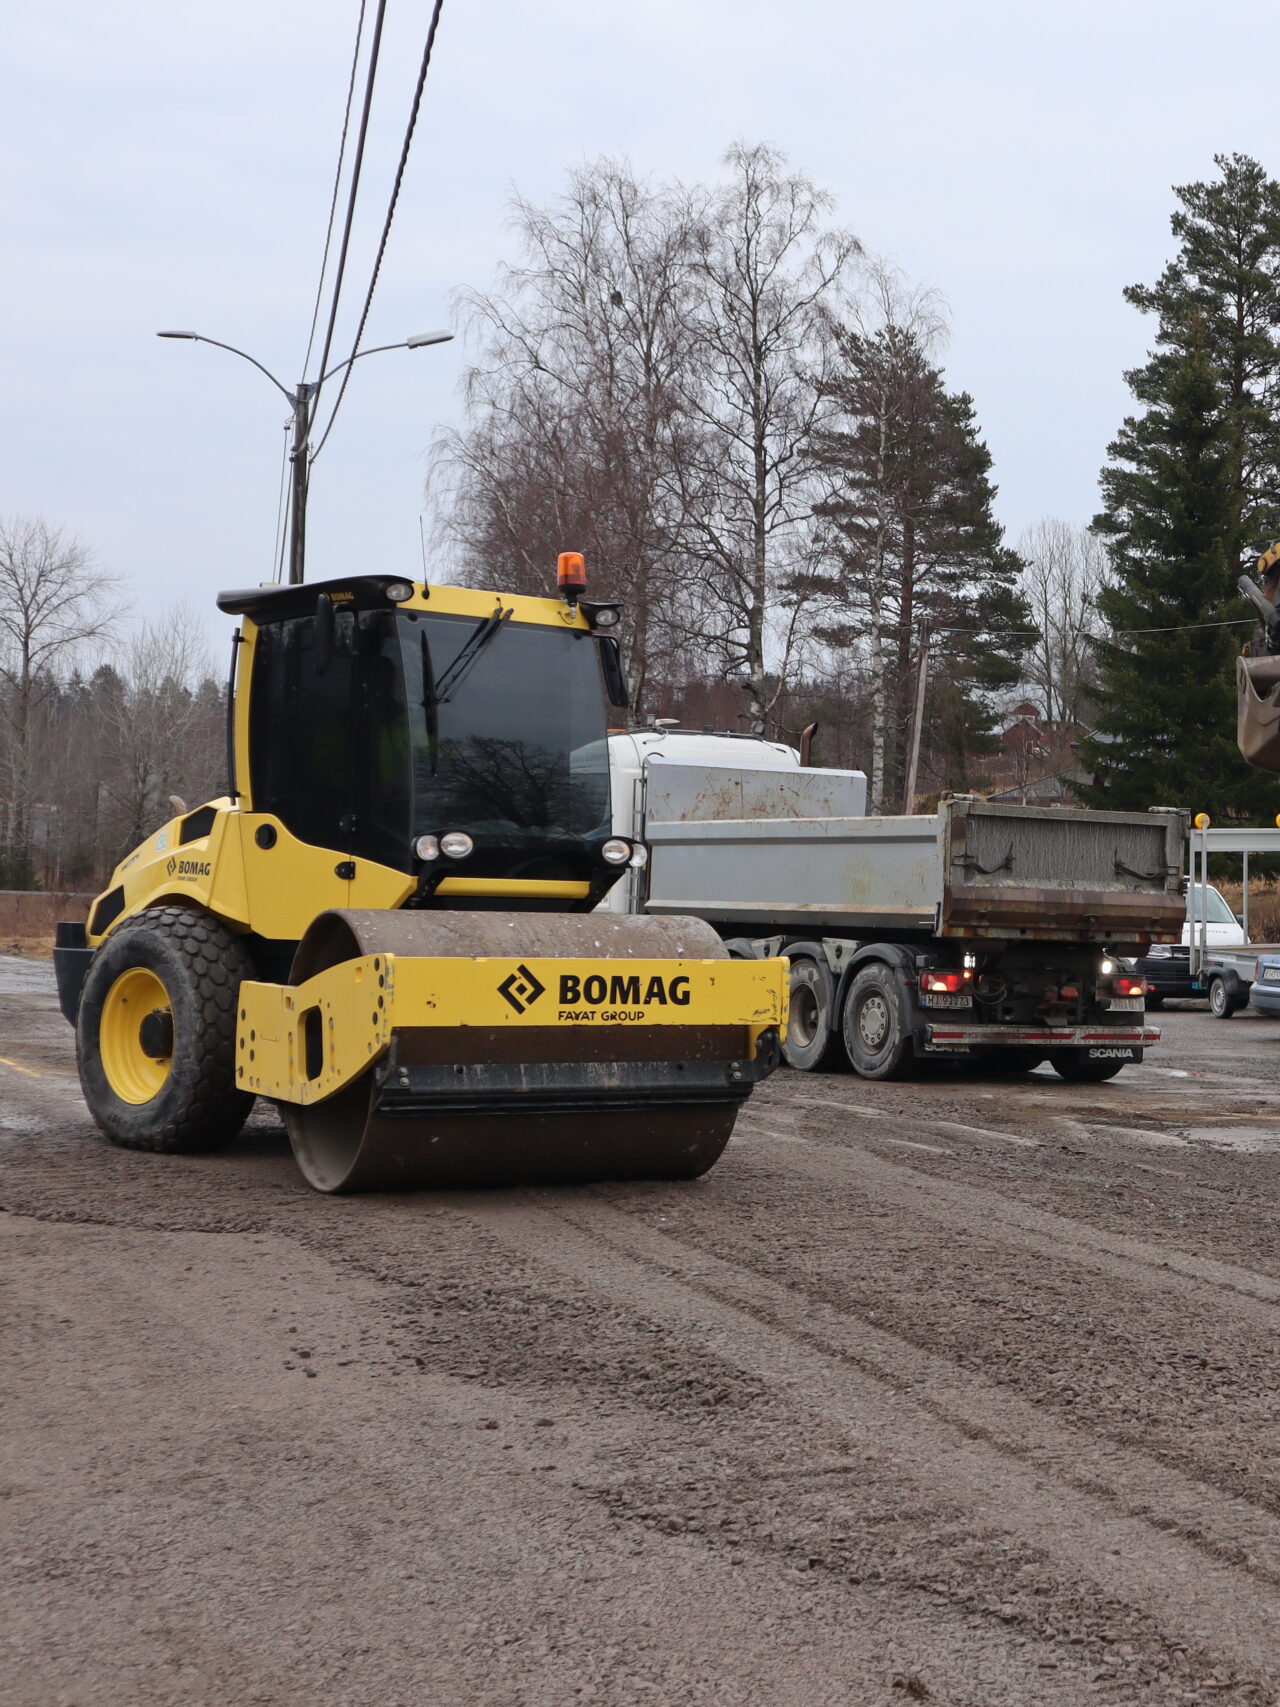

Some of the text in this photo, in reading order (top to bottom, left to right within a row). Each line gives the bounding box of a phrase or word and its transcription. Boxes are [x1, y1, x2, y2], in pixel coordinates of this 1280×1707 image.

[178, 860, 211, 876] BOMAG
[558, 974, 691, 1006] BOMAG
[558, 1011, 645, 1021] FAYAT GROUP
[1088, 1048, 1134, 1058] SCANIA
